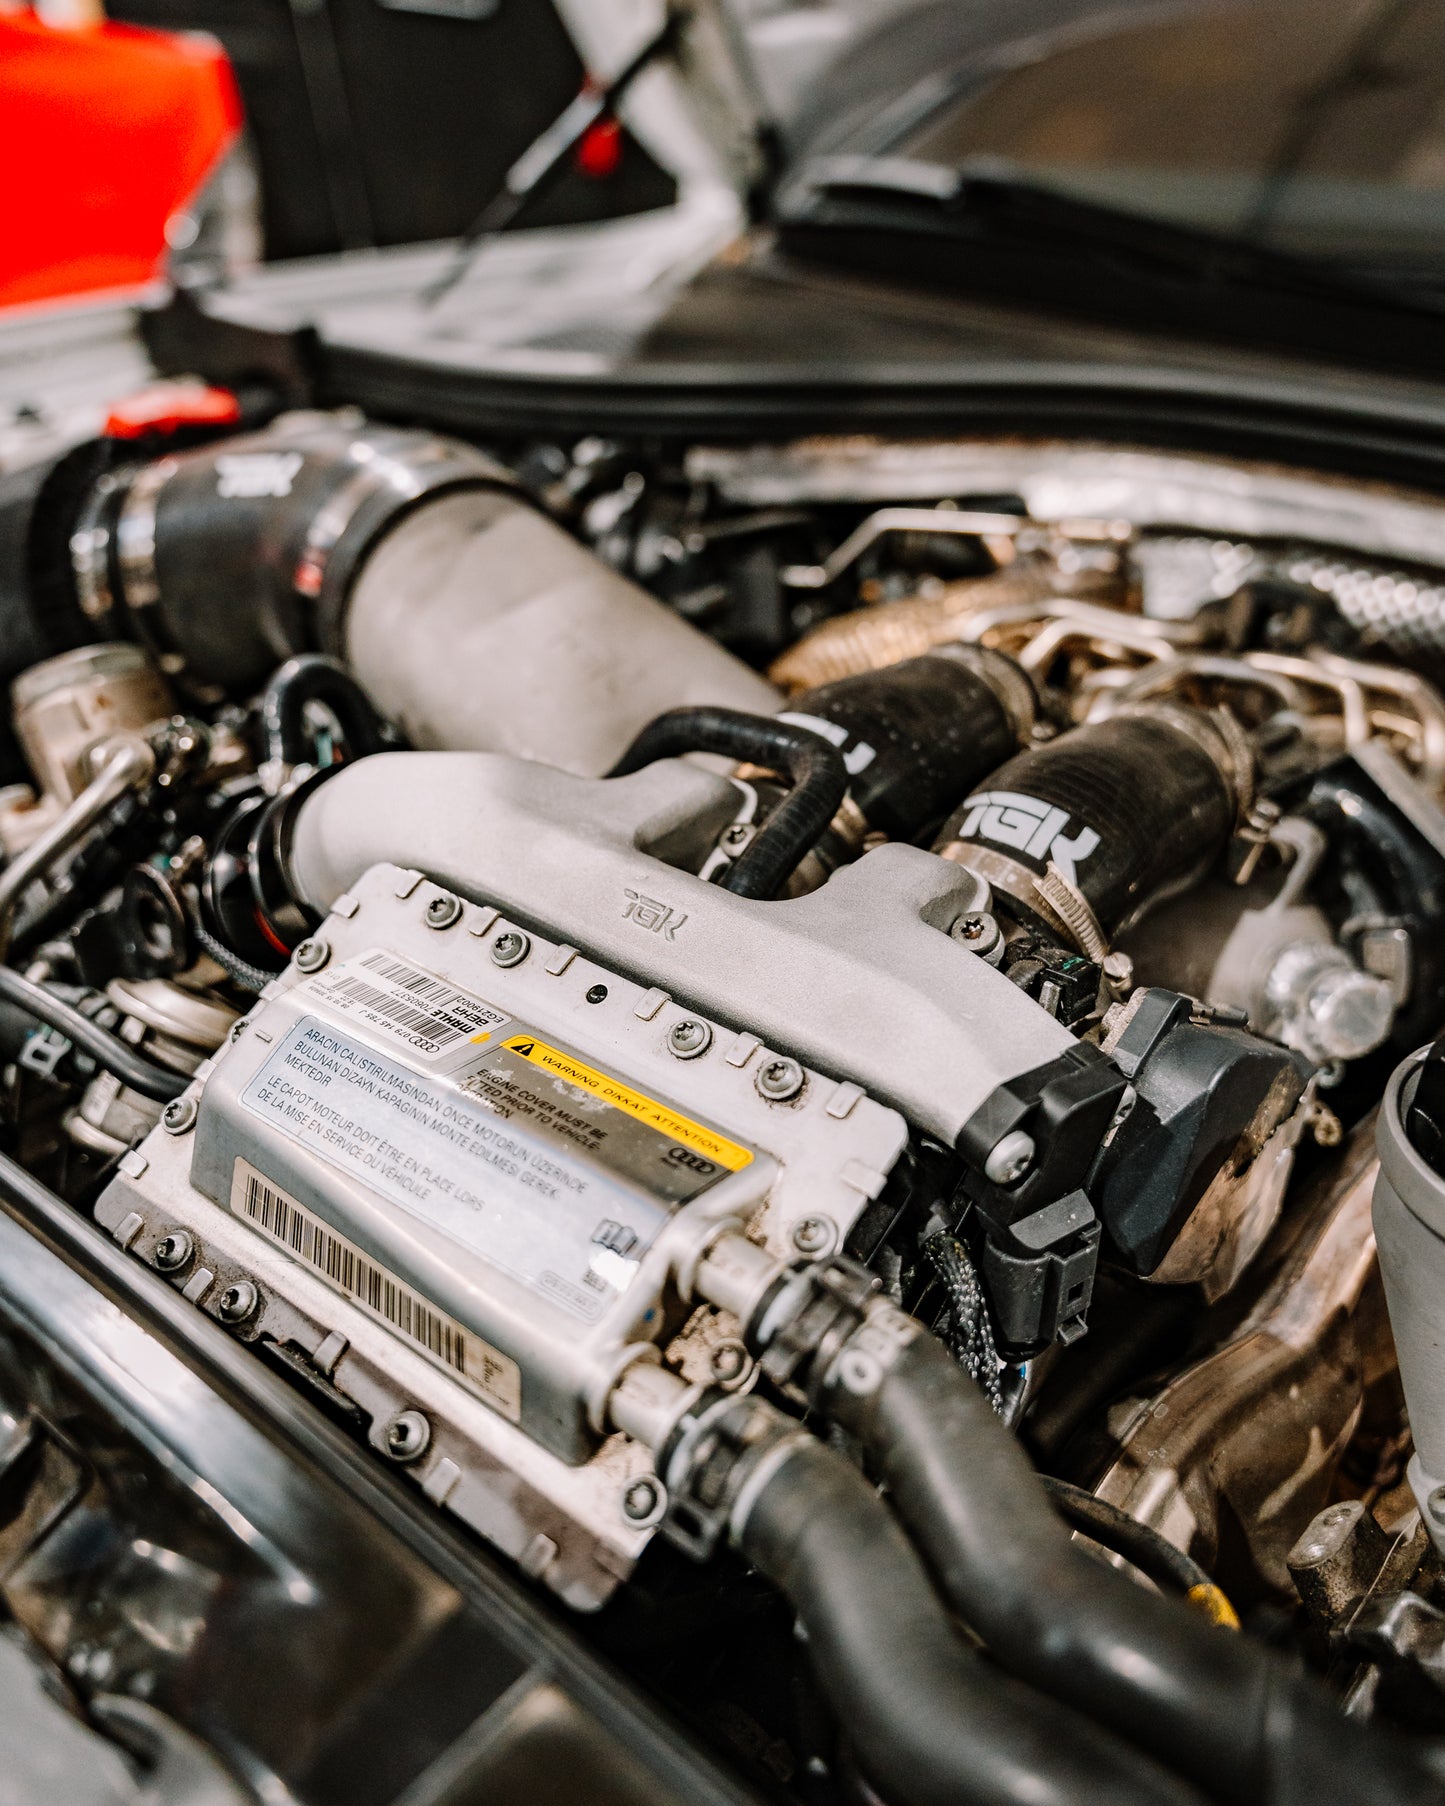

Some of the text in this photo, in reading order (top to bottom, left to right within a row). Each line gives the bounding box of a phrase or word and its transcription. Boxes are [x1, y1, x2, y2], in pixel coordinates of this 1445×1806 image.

[379, 1019, 395, 1030] 145
[389, 986, 476, 1034] MAHLE 70605377
[393, 1027, 411, 1039] 079
[451, 1004, 489, 1026] BEHR
[455, 995, 504, 1023] EG219002
[293, 1040, 342, 1073] BULUNAN
[373, 1086, 431, 1125] KAPAGININ
[428, 1117, 470, 1148] MONTE
[303, 1028, 341, 1054] ARACIN
[472, 1122, 532, 1162] MOTORUN
[476, 1067, 609, 1141] ENGINE COVER MUST BE
[499, 1093, 534, 1115] PRIOR
[534, 1110, 552, 1125] TO
[542, 1054, 722, 1152] WARNING DIKKAT ATTENTION
[256, 1087, 273, 1103] DE
[270, 1096, 284, 1111] LA
[283, 1104, 309, 1126] MISE
[307, 1119, 324, 1135] EN
[321, 1128, 365, 1160] SERVICE
[362, 1152, 383, 1170] DU
[266, 1074, 282, 1089] LE
[278, 1081, 314, 1108] CAPOT
[309, 1100, 355, 1133] MOTEUR
[352, 1126, 380, 1148] DOIT
[402, 1156, 422, 1173] EN
[418, 1166, 456, 1194] PLACE
[452, 1187, 486, 1213] LORS
